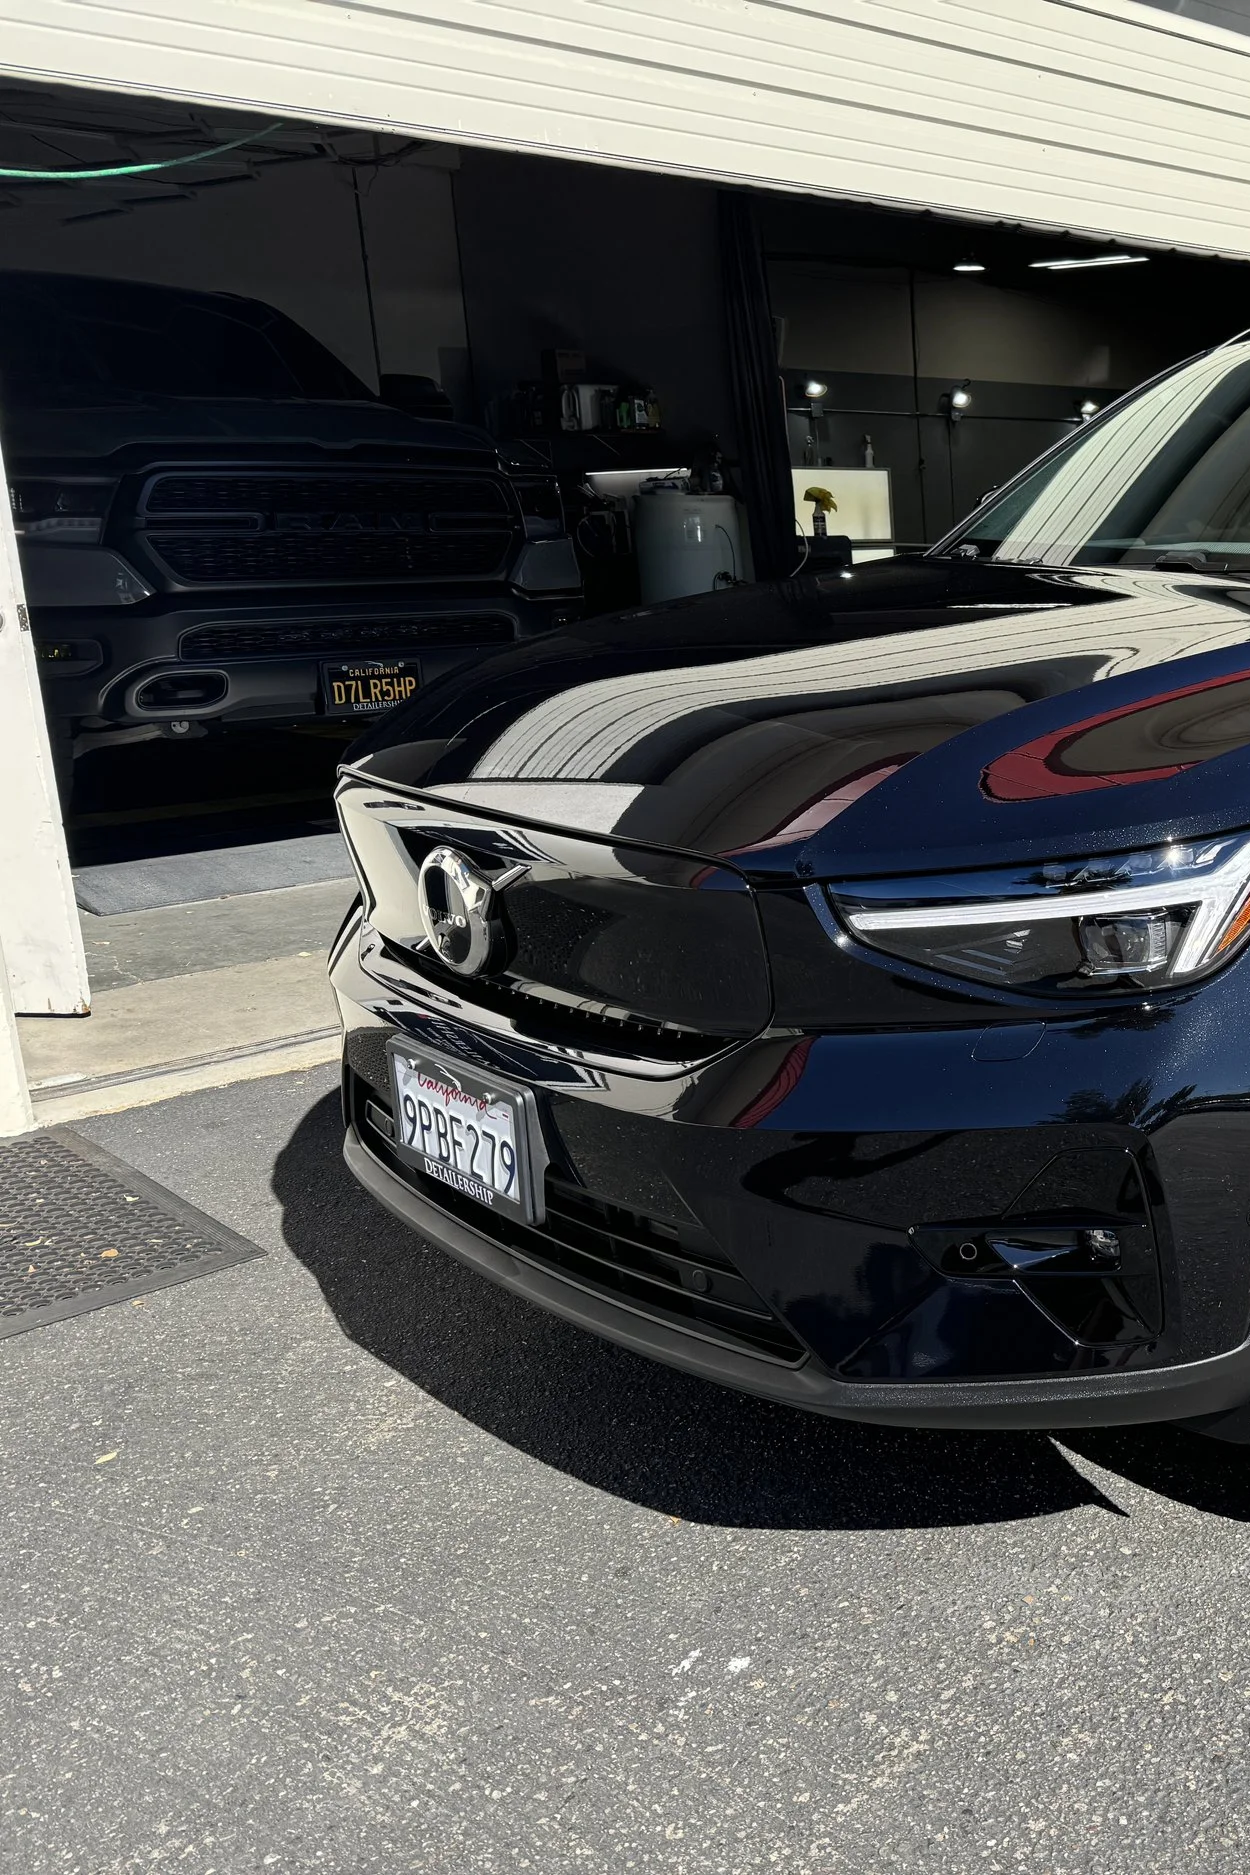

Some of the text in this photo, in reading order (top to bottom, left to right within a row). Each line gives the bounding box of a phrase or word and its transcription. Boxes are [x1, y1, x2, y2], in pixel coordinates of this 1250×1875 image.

[274, 511, 424, 531] RAM
[349, 666, 399, 677] CALIFORNIA
[332, 676, 416, 705] D7LR5HP
[422, 903, 467, 928] VOLVO
[402, 1093, 515, 1194] 9PBF279
[424, 1157, 494, 1206] DETAILERSHIP
